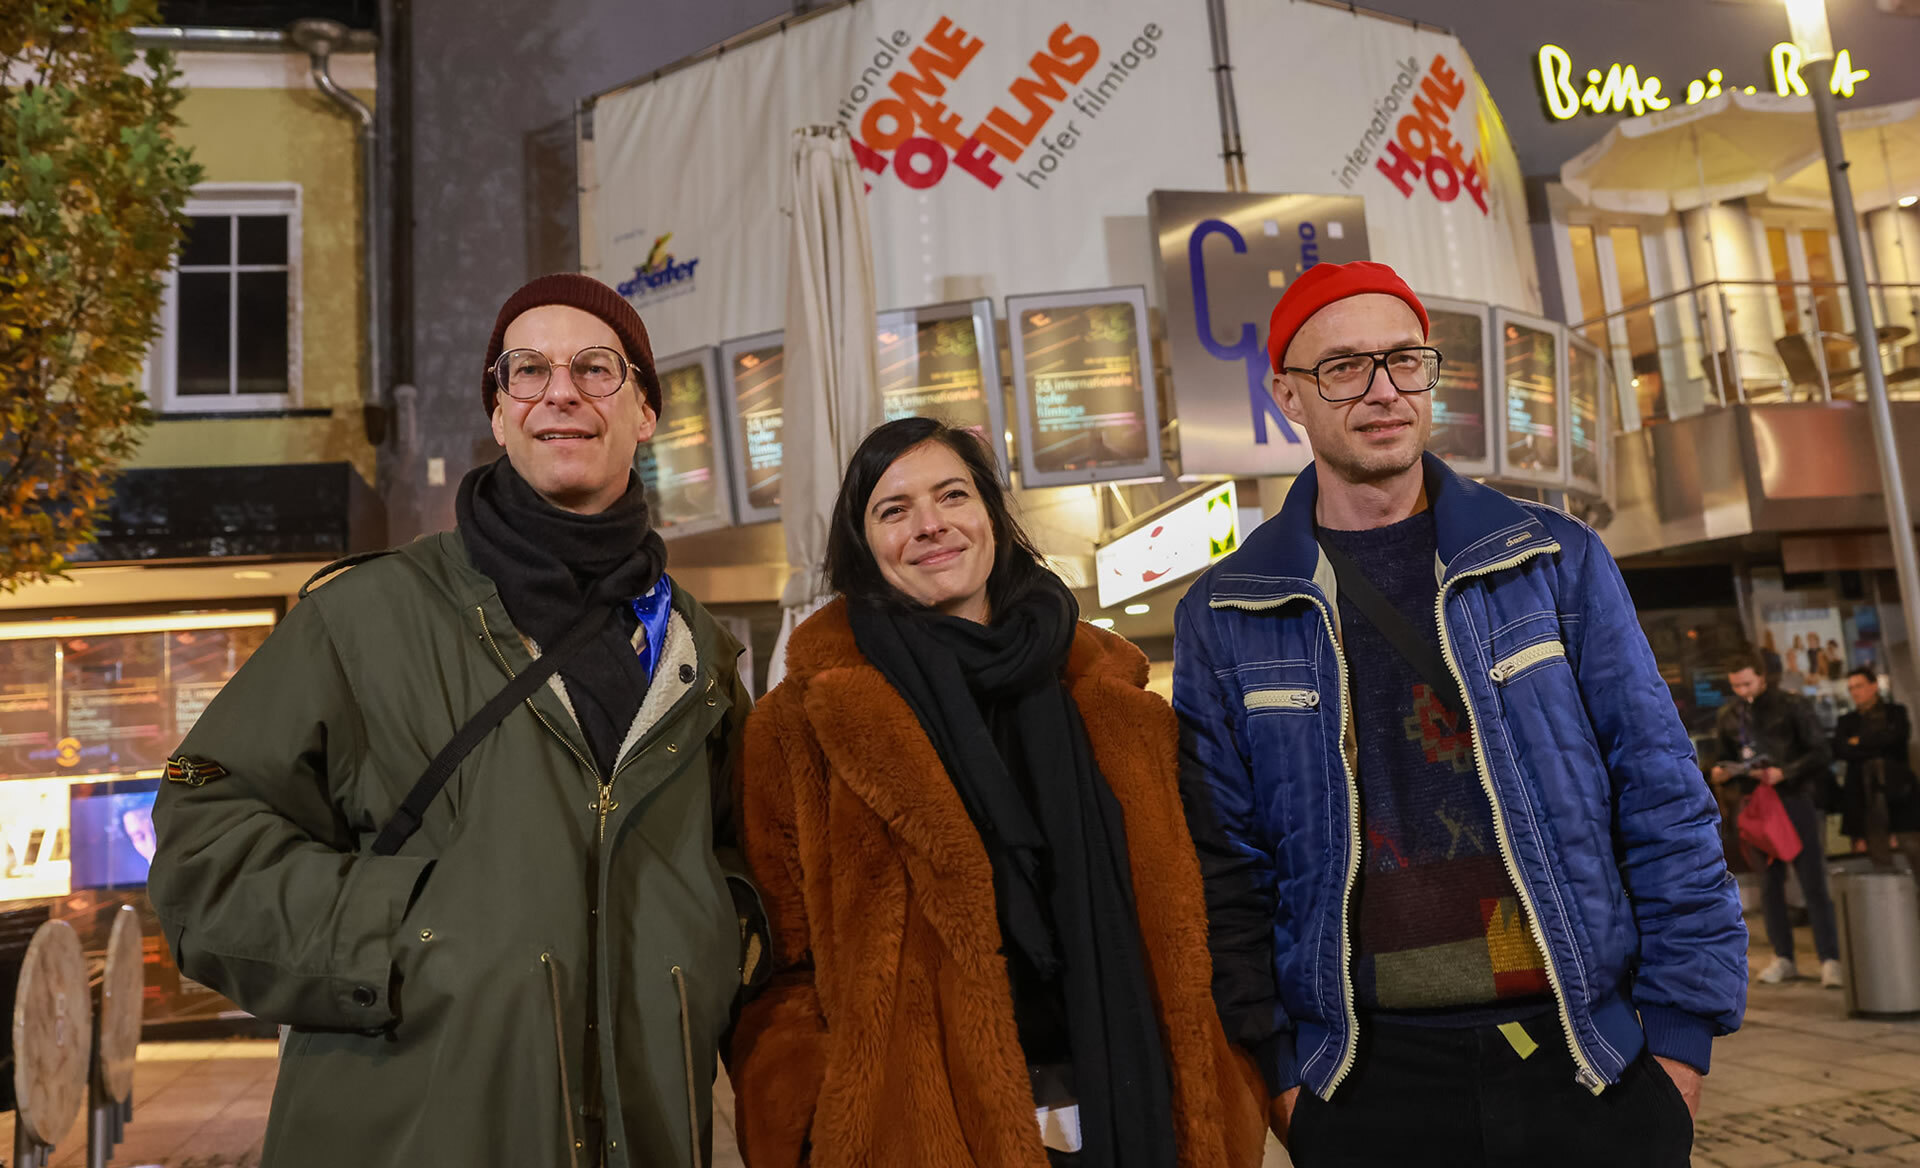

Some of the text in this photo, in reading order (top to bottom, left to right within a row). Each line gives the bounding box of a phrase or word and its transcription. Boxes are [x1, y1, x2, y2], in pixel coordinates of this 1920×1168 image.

[952, 22, 1100, 191] FILMS
[1016, 21, 1163, 190] hofer filmtage
[1331, 55, 1420, 190] internationale
[1376, 52, 1465, 200] HOME
[1539, 44, 1671, 119] Bitte
